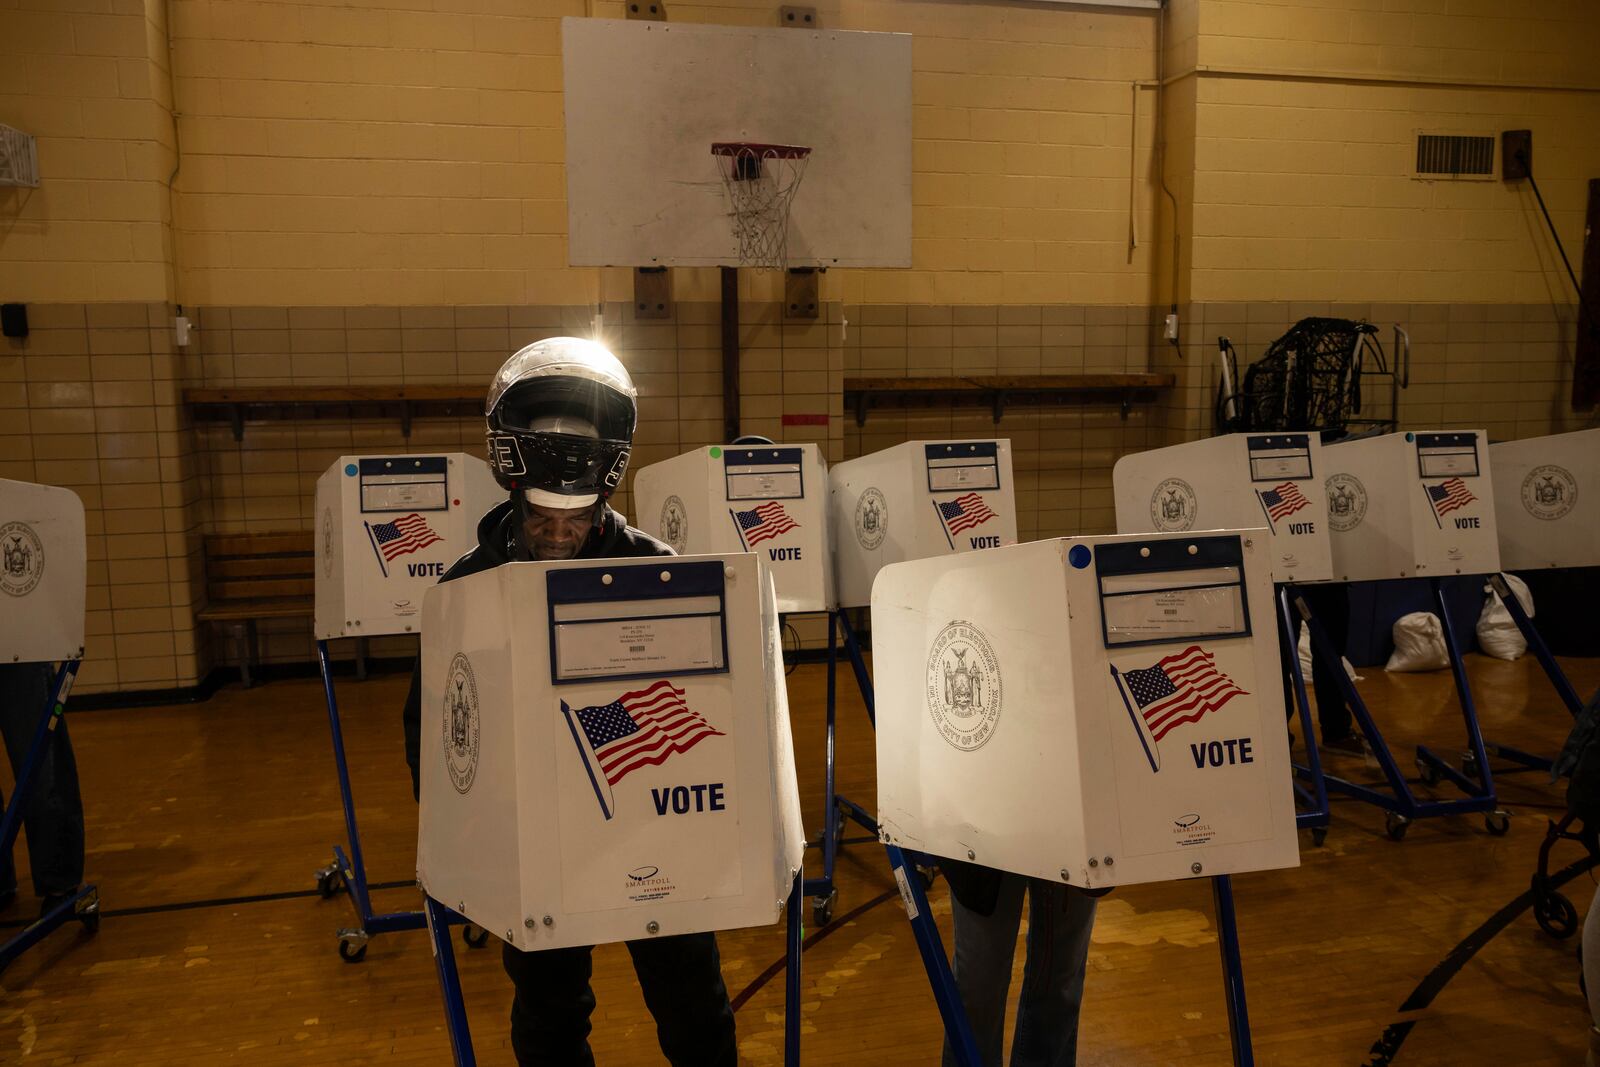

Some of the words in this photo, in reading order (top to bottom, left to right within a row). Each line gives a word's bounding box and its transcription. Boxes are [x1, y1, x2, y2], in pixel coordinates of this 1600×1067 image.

[1289, 523, 1314, 535] VOTE
[1455, 517, 1480, 529] VOTE
[970, 536, 1000, 549] VOTE
[769, 548, 801, 561] VOTE
[408, 563, 444, 577] VOTE
[947, 628, 957, 640] OF
[961, 735, 972, 745] OF
[1191, 738, 1253, 768] VOTE
[651, 783, 725, 815] VOTE
[625, 878, 671, 889] SMARTPOLL
